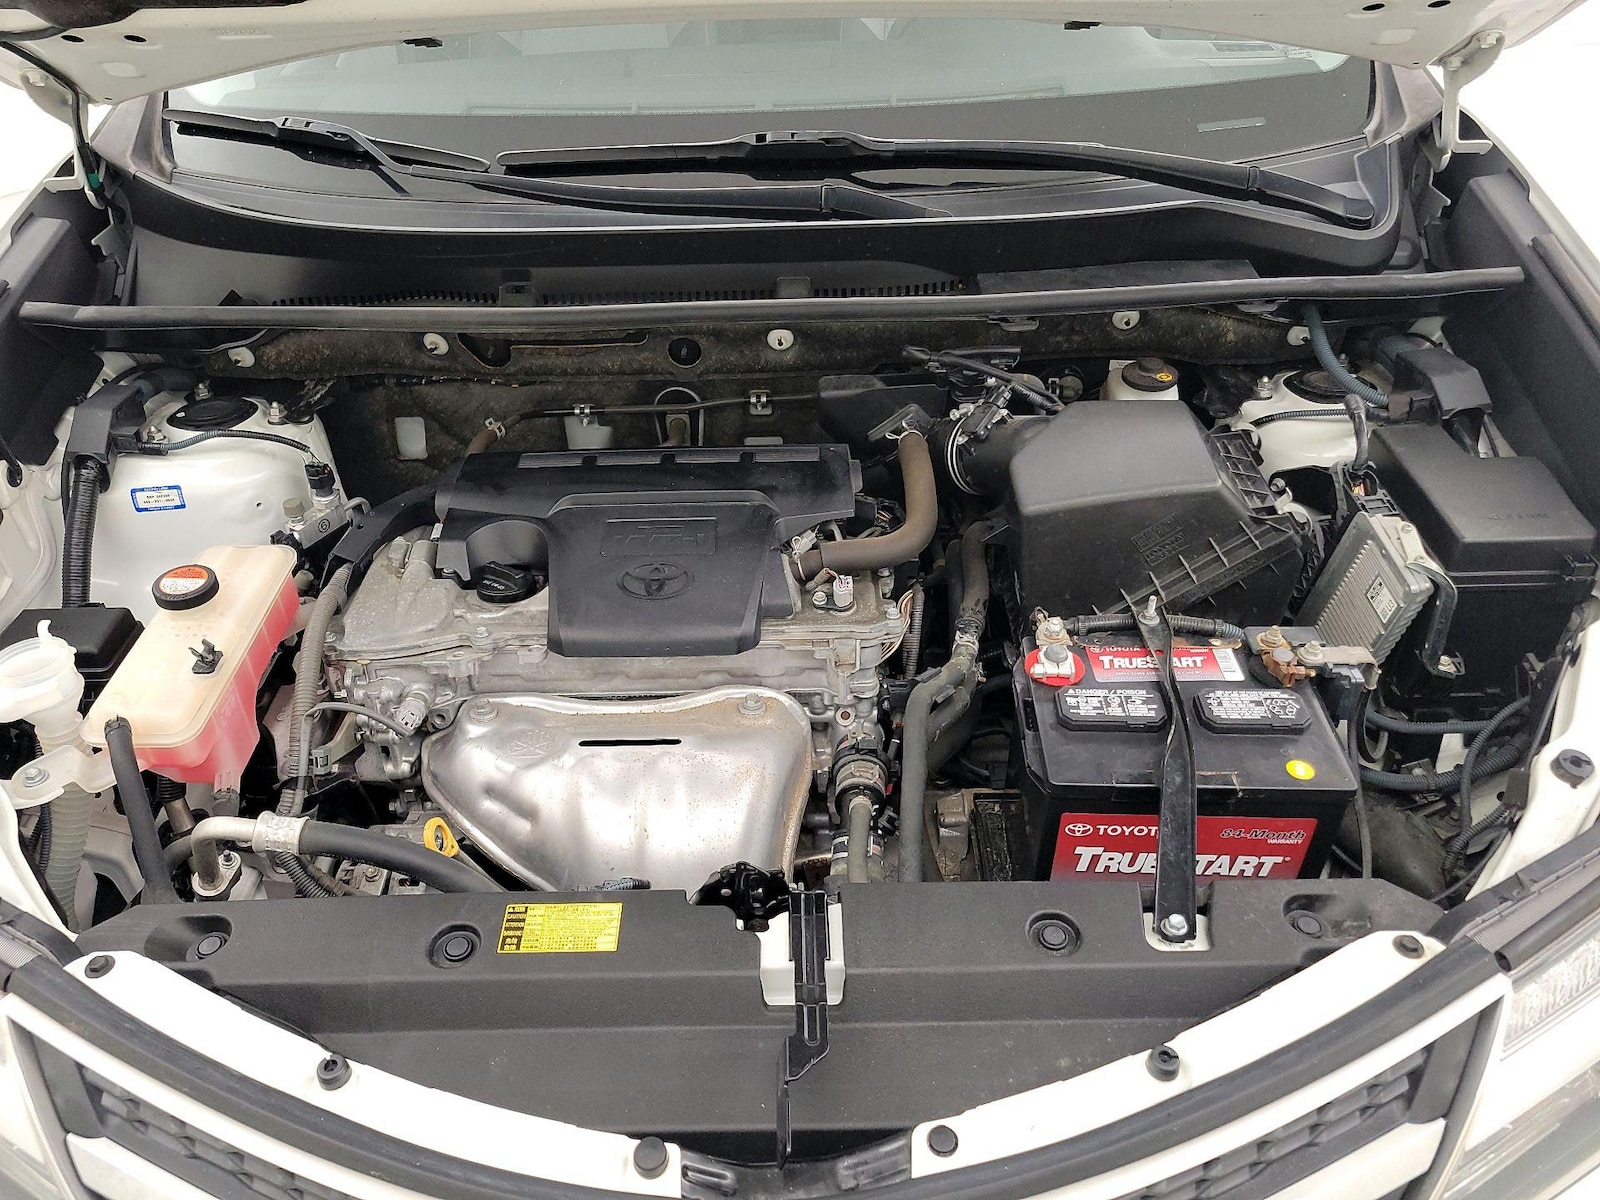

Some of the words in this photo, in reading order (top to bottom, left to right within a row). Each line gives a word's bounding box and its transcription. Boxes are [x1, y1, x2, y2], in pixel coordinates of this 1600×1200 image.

[1099, 655, 1204, 669] TRUESART
[1096, 825, 1158, 837] TOYOT
[1074, 846, 1284, 878] TRUETART
